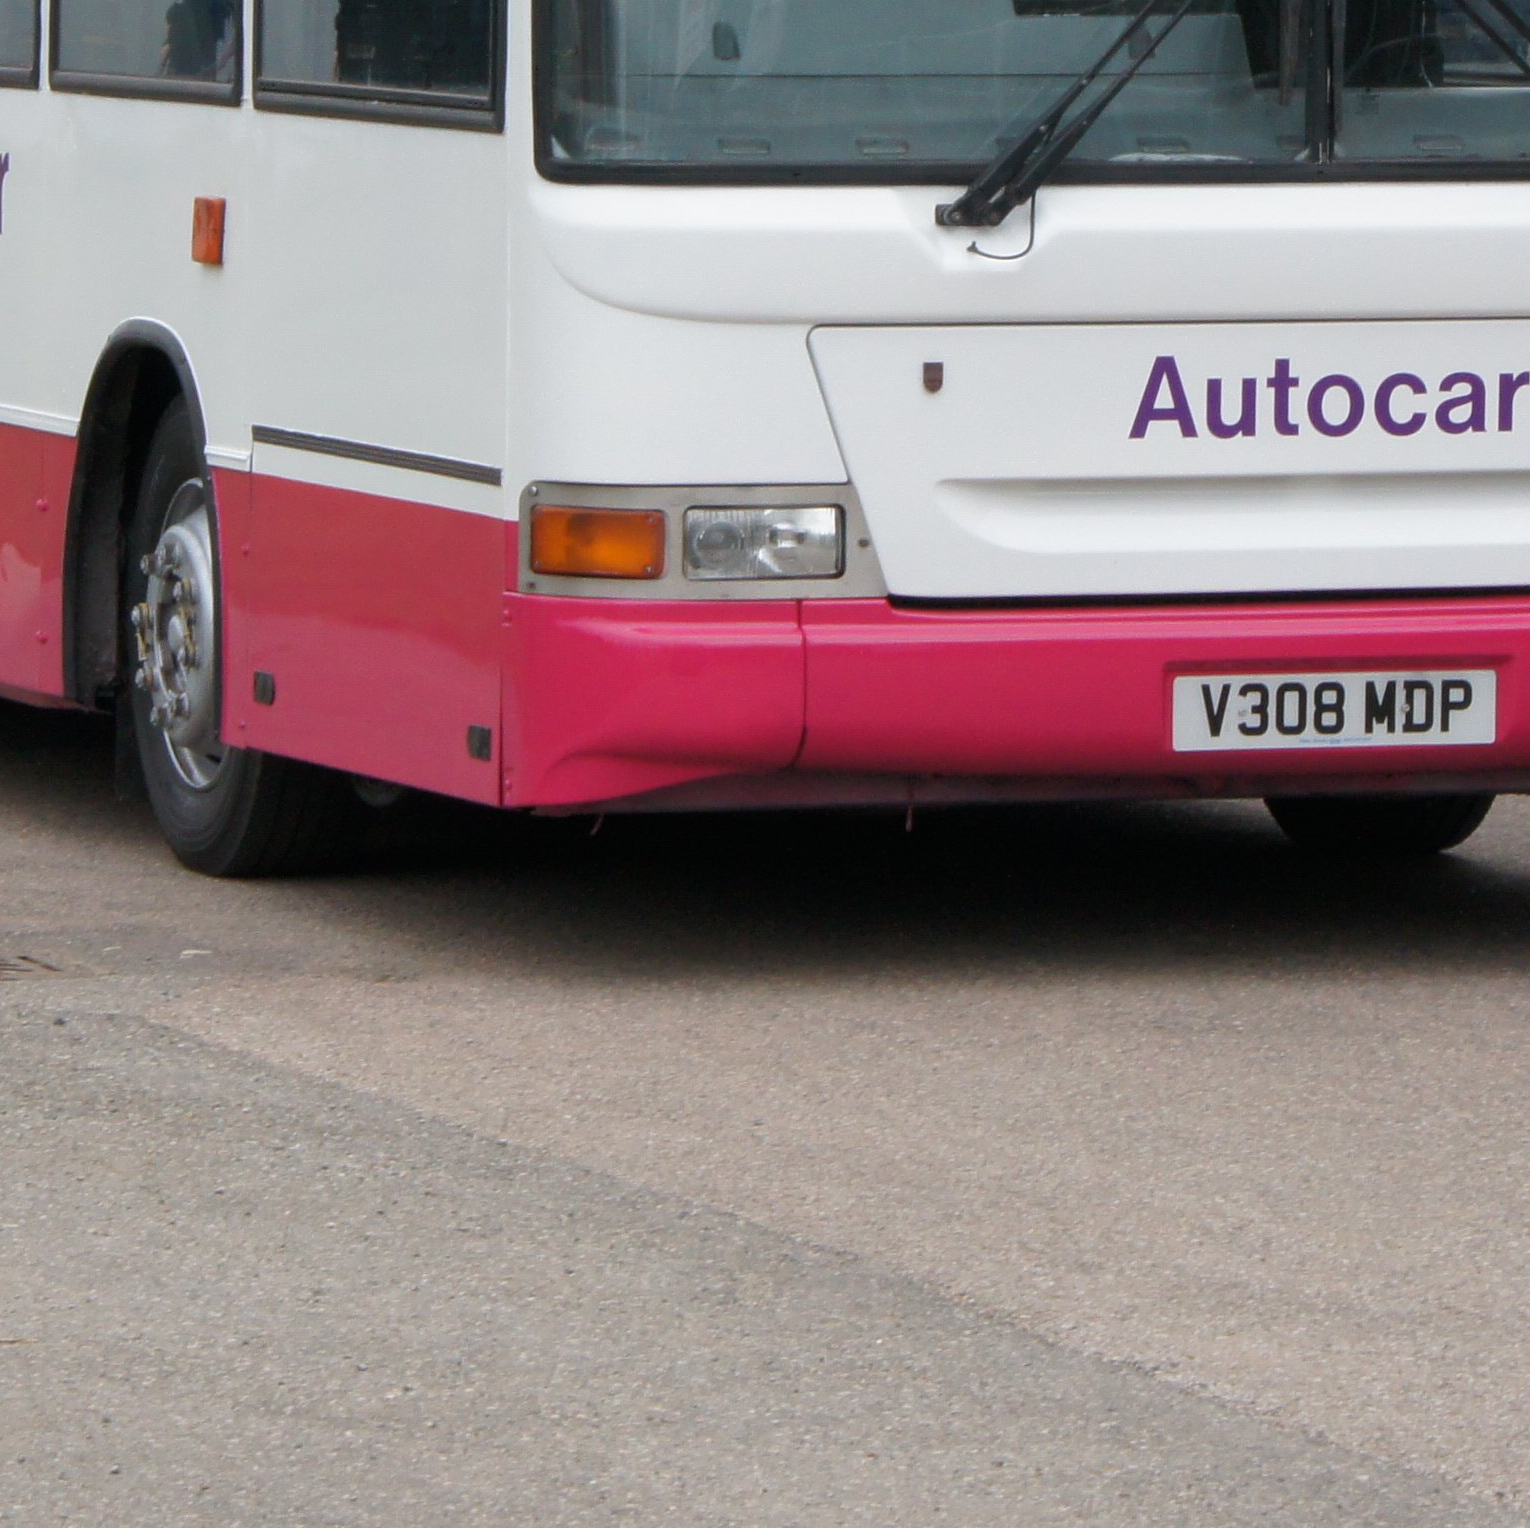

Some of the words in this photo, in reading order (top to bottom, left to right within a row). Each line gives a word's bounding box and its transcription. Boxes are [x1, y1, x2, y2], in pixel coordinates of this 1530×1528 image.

[1128, 355, 1530, 438] Autocar
[1201, 681, 1345, 737] V308
[1364, 679, 1473, 734] MDP
